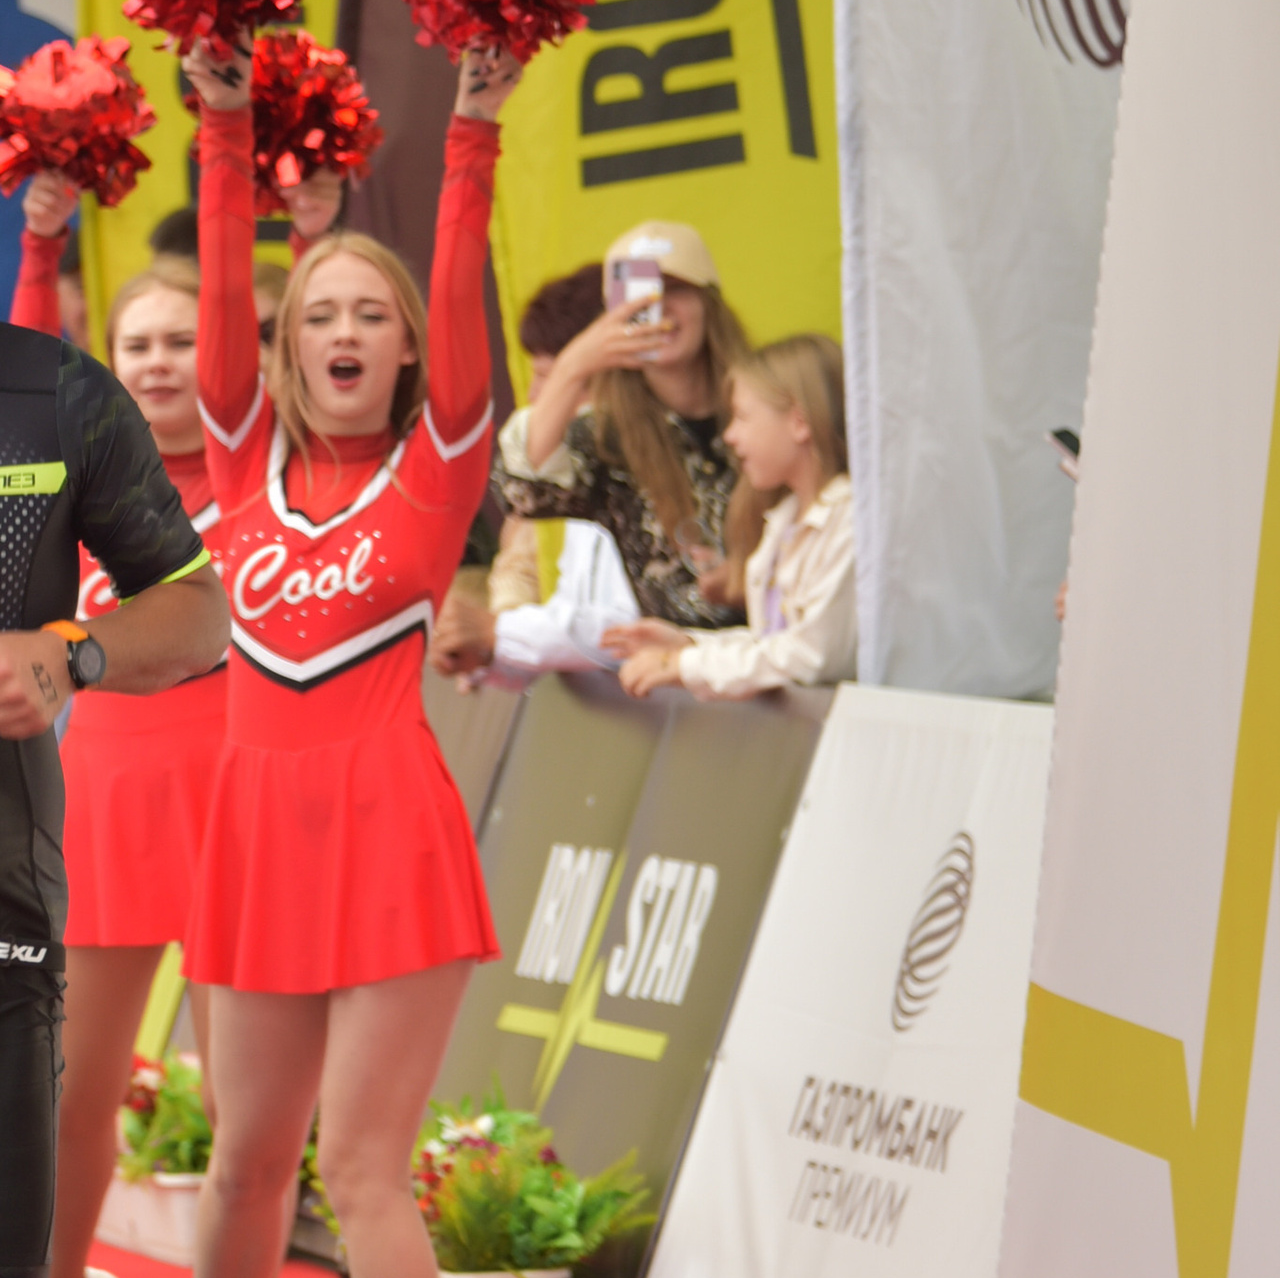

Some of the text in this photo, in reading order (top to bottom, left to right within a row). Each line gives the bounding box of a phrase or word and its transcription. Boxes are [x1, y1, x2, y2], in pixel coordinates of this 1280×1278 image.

[233, 537, 373, 620] Cool
[605, 854, 718, 1005] STAR
[787, 1076, 965, 1174] ГАЗПРОМБАНК
